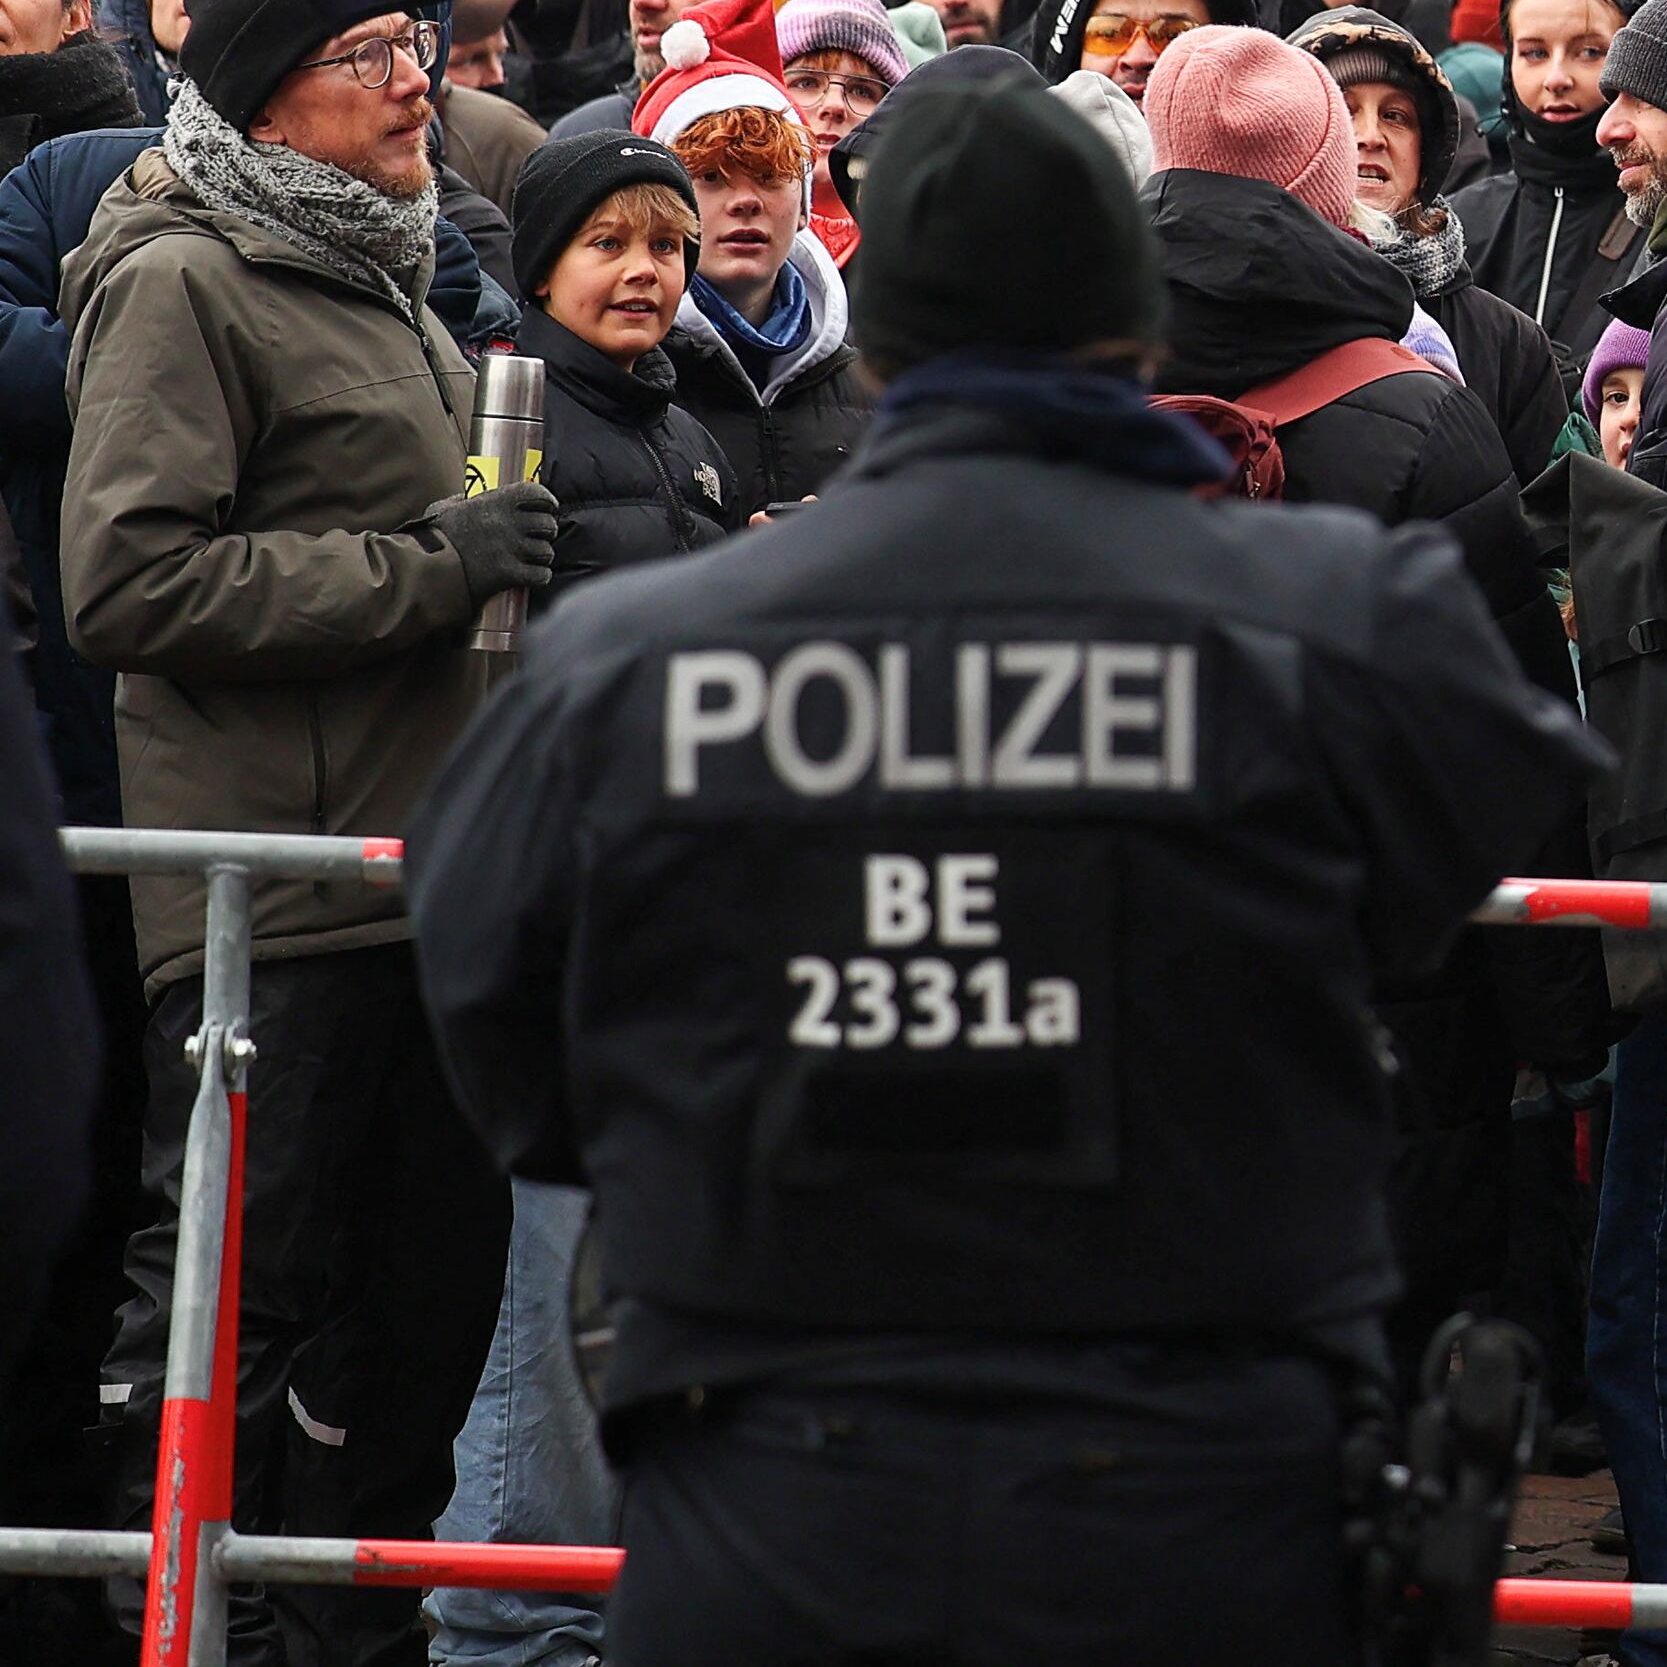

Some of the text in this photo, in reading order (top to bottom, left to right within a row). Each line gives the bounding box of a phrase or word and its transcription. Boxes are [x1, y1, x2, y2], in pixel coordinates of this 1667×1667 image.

[664, 641, 1196, 797] POLIZEI
[864, 855, 1000, 946] BE
[787, 957, 1081, 1048] 2331a
